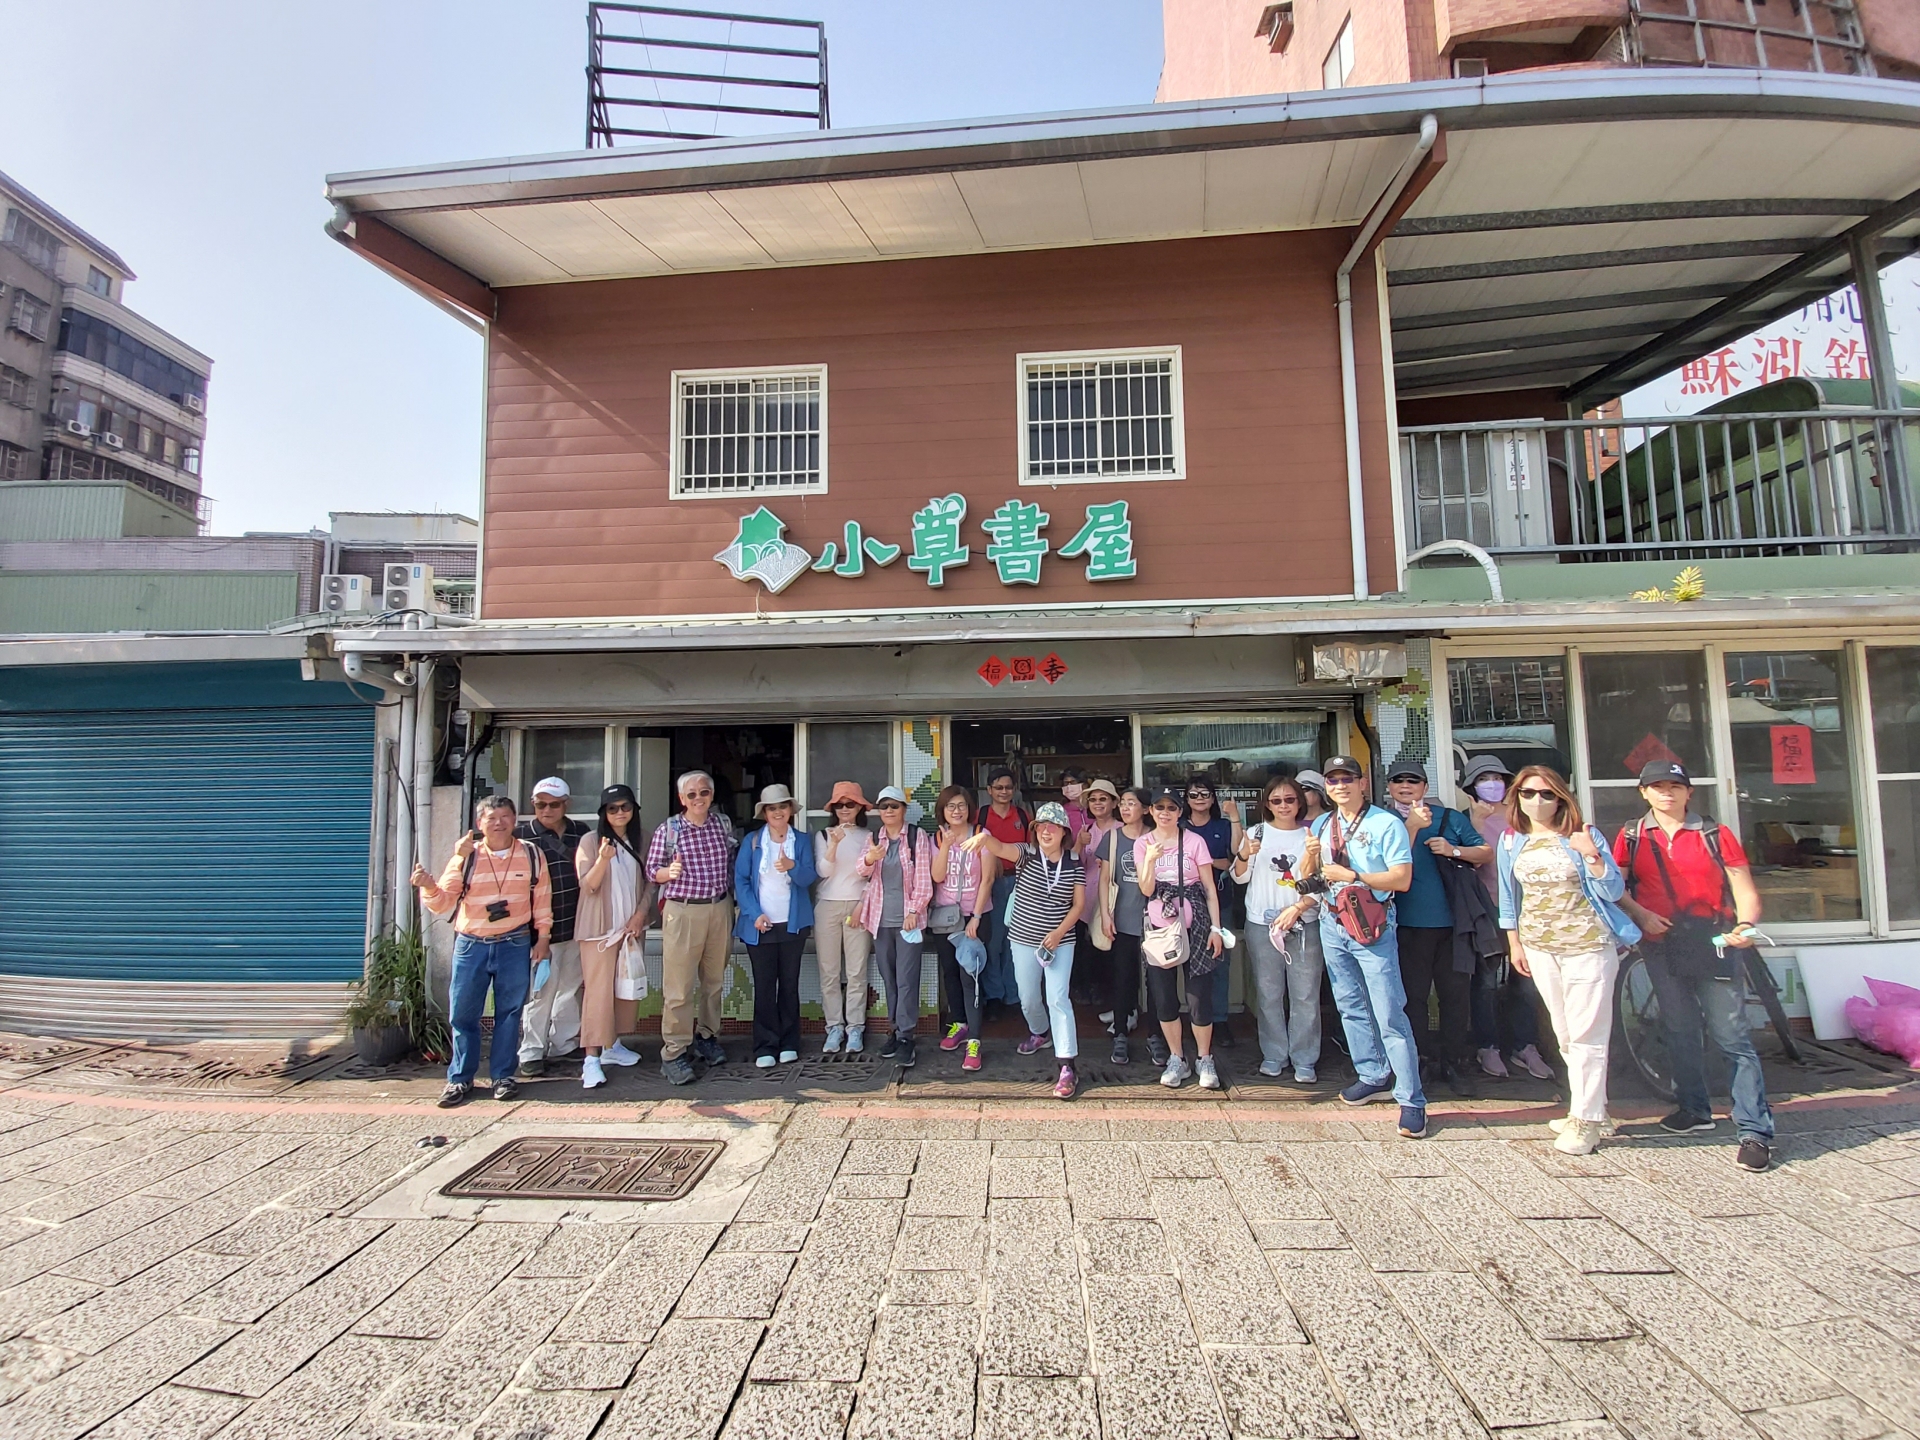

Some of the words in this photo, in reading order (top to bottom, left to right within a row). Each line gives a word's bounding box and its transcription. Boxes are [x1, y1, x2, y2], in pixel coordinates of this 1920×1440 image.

[811, 493, 1137, 588] 小草書屋
[983, 662, 1001, 680] 福
[1043, 657, 1066, 682] 春
